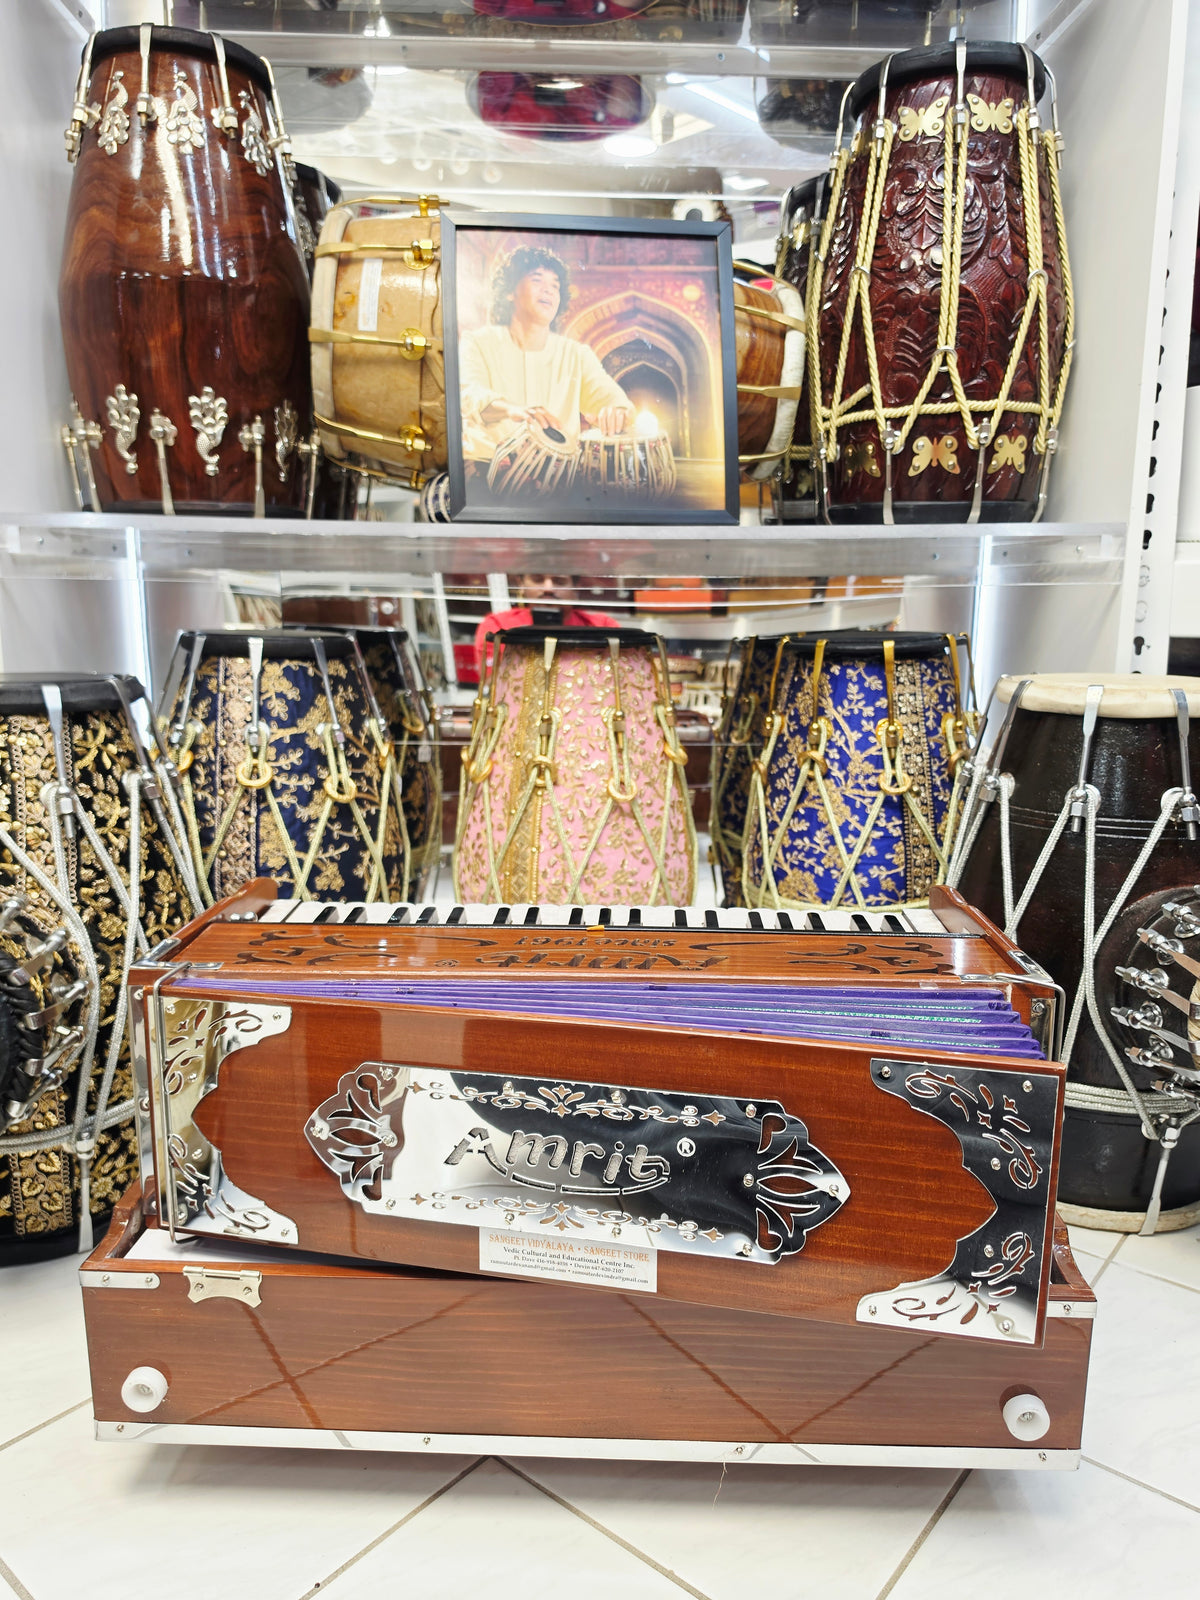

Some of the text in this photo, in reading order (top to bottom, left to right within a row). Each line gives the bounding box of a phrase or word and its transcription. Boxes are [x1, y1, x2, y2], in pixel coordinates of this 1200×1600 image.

[515, 936, 587, 946] 1961
[475, 951, 729, 971] Amrit
[443, 1127, 671, 1184] Amrit
[489, 1233, 650, 1262] SANGEET VIDYALAYA SANGEET STORE
[503, 1246, 520, 1254] Vedic
[522, 1248, 547, 1257] Cultural
[562, 1254, 599, 1264] Educational
[601, 1259, 621, 1267] Centre
[623, 1261, 635, 1269] Inc.
